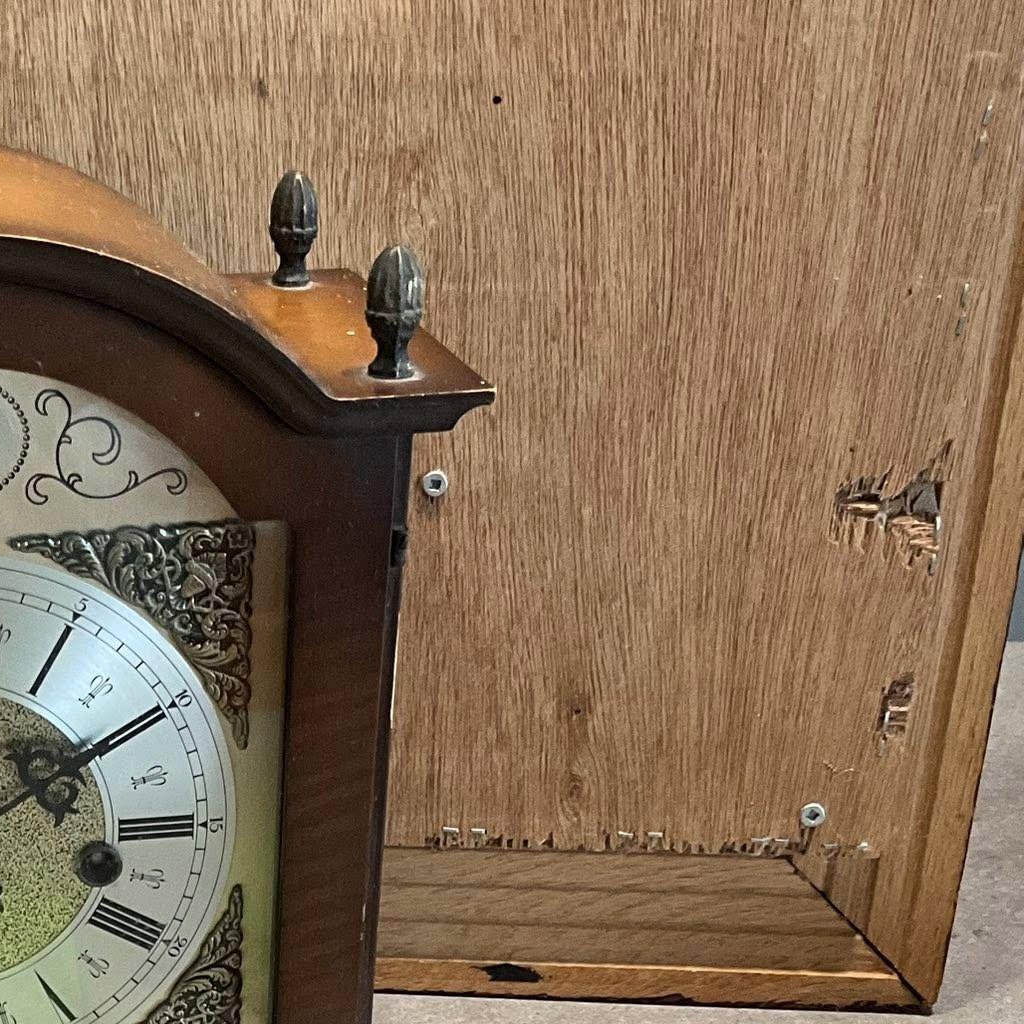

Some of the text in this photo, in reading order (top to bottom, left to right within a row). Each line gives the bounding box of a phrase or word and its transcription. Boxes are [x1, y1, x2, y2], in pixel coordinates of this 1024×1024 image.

[74, 598, 89, 613] 5
[26, 622, 74, 697] I
[174, 688, 193, 709] 10
[118, 812, 195, 844] III
[208, 815, 223, 834] 15
[166, 935, 188, 958] 20
